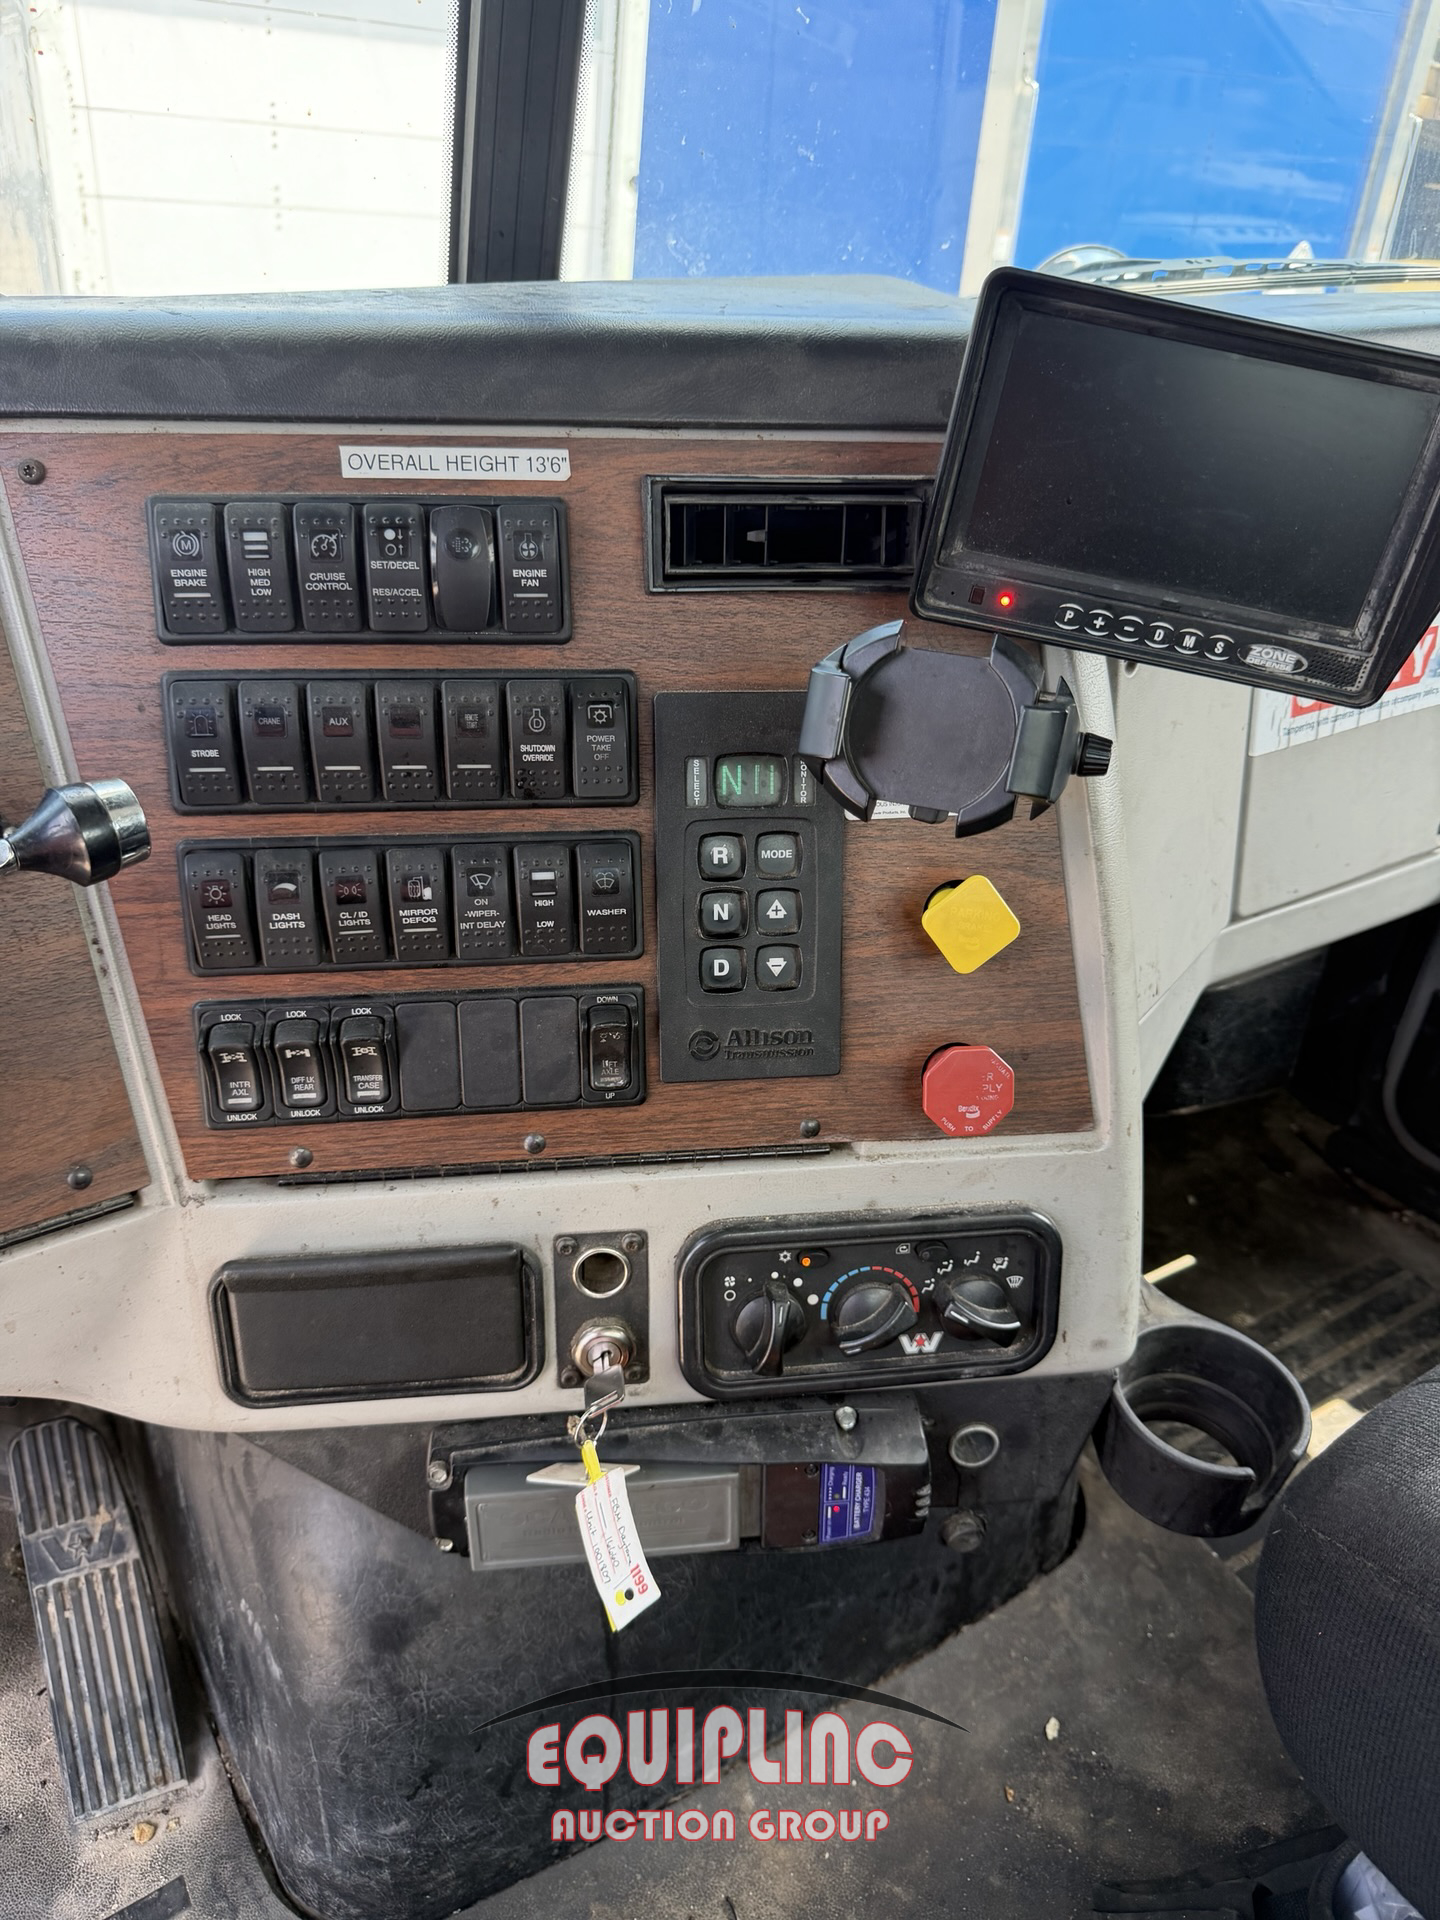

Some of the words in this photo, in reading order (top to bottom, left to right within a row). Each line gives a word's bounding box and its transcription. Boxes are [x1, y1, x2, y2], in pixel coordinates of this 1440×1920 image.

[348, 453, 440, 472] OVERALL
[446, 455, 519, 473] HEIGHT
[526, 456, 567, 473] 13'6"
[370, 560, 420, 570] SET/DECEL
[170, 568, 208, 578] ENGINE
[248, 568, 271, 577] HIGH
[309, 572, 346, 581] CRUISE
[512, 569, 548, 578] ENGINE
[174, 578, 207, 588] BRAKE
[250, 578, 271, 587] MED
[305, 582, 353, 591] CONTROL
[521, 578, 539, 587] FAN
[251, 587, 272, 597] LOW
[372, 588, 422, 597] RES/ACCEL
[1064, 610, 1075, 622] P
[1153, 628, 1165, 642] D
[1182, 635, 1197, 649] M
[1214, 642, 1226, 654] S
[1249, 645, 1298, 665] ZONE
[1246, 657, 1294, 672] DEFENSE
[258, 717, 281, 726] CRANE
[329, 717, 349, 726] AUX
[586, 735, 616, 743] POWER
[520, 744, 556, 753] SHUTDOWN
[591, 744, 612, 752] TAKE
[191, 749, 220, 758] STROBE
[522, 754, 554, 762] OVERRIDE
[593, 753, 610, 761] OFF
[712, 846, 729, 865] R
[761, 849, 793, 859] MODE
[474, 898, 489, 907] ON
[534, 899, 554, 908] HIGH
[272, 912, 301, 921] DASH
[399, 908, 439, 917] MIRROR
[587, 908, 627, 917] WASHER
[713, 903, 729, 921] N
[207, 914, 232, 922] HEAD
[338, 918, 372, 927] LIGHTS
[402, 916, 437, 925] DEFOG
[206, 922, 237, 930] LIGHTS
[269, 921, 306, 930] LIGHTS
[460, 922, 475, 930] INT
[476, 920, 506, 930] DELAY
[536, 920, 555, 928] LOW
[713, 959, 730, 977] D
[596, 996, 619, 1004] DOWN
[286, 1010, 307, 1019] LOCK
[351, 1008, 372, 1016] LOCK
[221, 1014, 242, 1022] LOCK
[726, 1028, 814, 1046] Allison
[724, 1047, 815, 1060] Transmission
[601, 1068, 620, 1076] AXLE
[353, 1074, 383, 1082] TRANSFER
[229, 1081, 251, 1089] INTR
[294, 1083, 315, 1091] REAR
[358, 1082, 380, 1090] CASE
[232, 1088, 249, 1097] AXL
[605, 1092, 616, 1100] UP
[290, 1109, 321, 1118] UNLOCK
[354, 1105, 384, 1114] UNLOCK
[227, 1114, 258, 1122] UNLOCK
[941, 1117, 957, 1132] PUSH
[982, 1109, 1003, 1131] SUPPLY
[854, 1471, 863, 1502] CHARGER
[862, 1496, 870, 1513] TYPE
[853, 1502, 862, 1529] BATTERY
[586, 1510, 597, 1536] Unit
[630, 1563, 649, 1595] 1199
